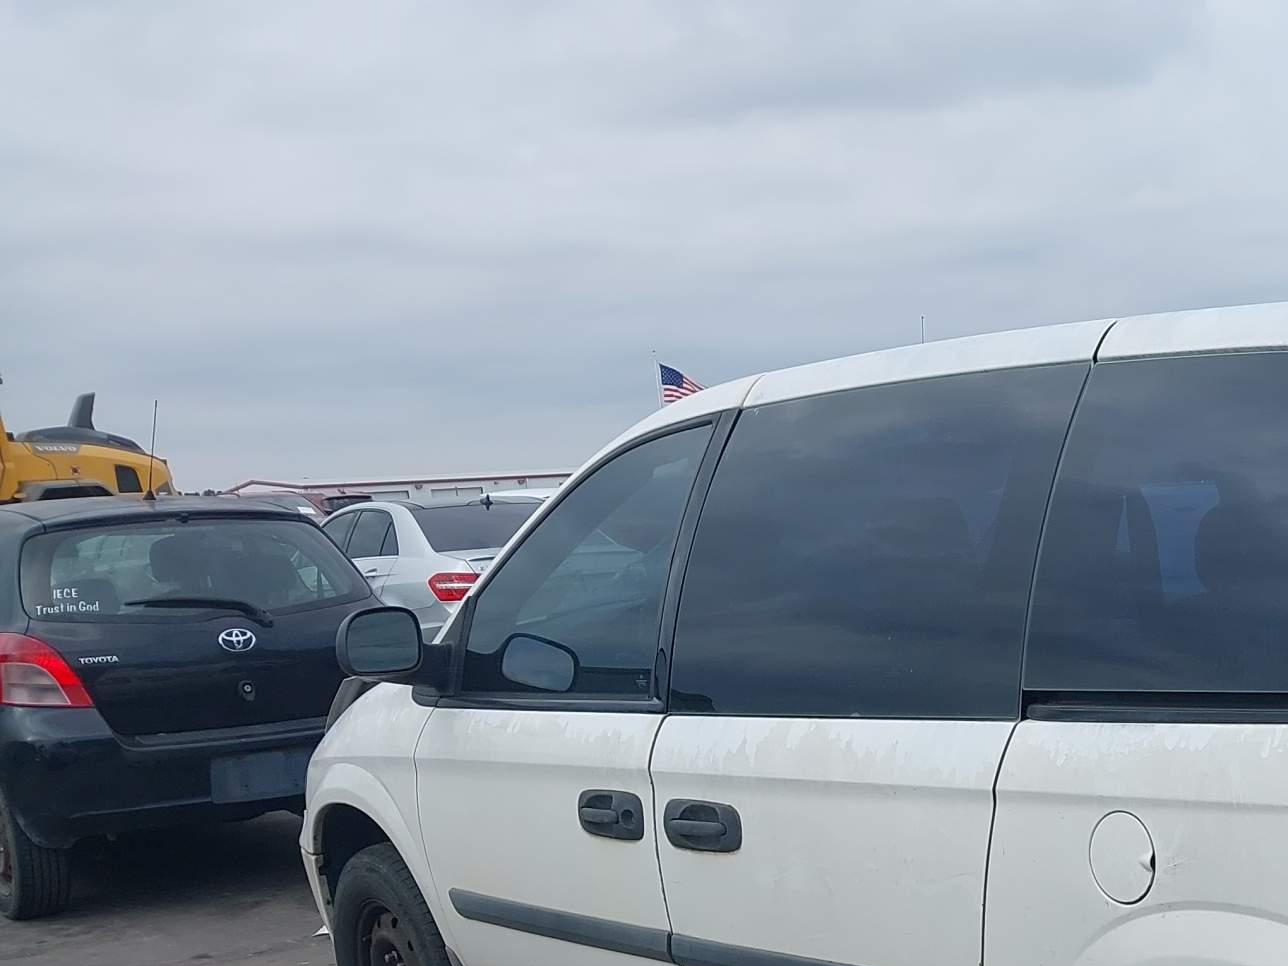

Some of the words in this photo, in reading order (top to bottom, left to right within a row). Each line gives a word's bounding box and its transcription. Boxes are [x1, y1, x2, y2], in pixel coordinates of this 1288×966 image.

[36, 603, 64, 616] Trust
[66, 603, 77, 613] in
[78, 600, 99, 612] God
[78, 655, 119, 665] TOYOTA
